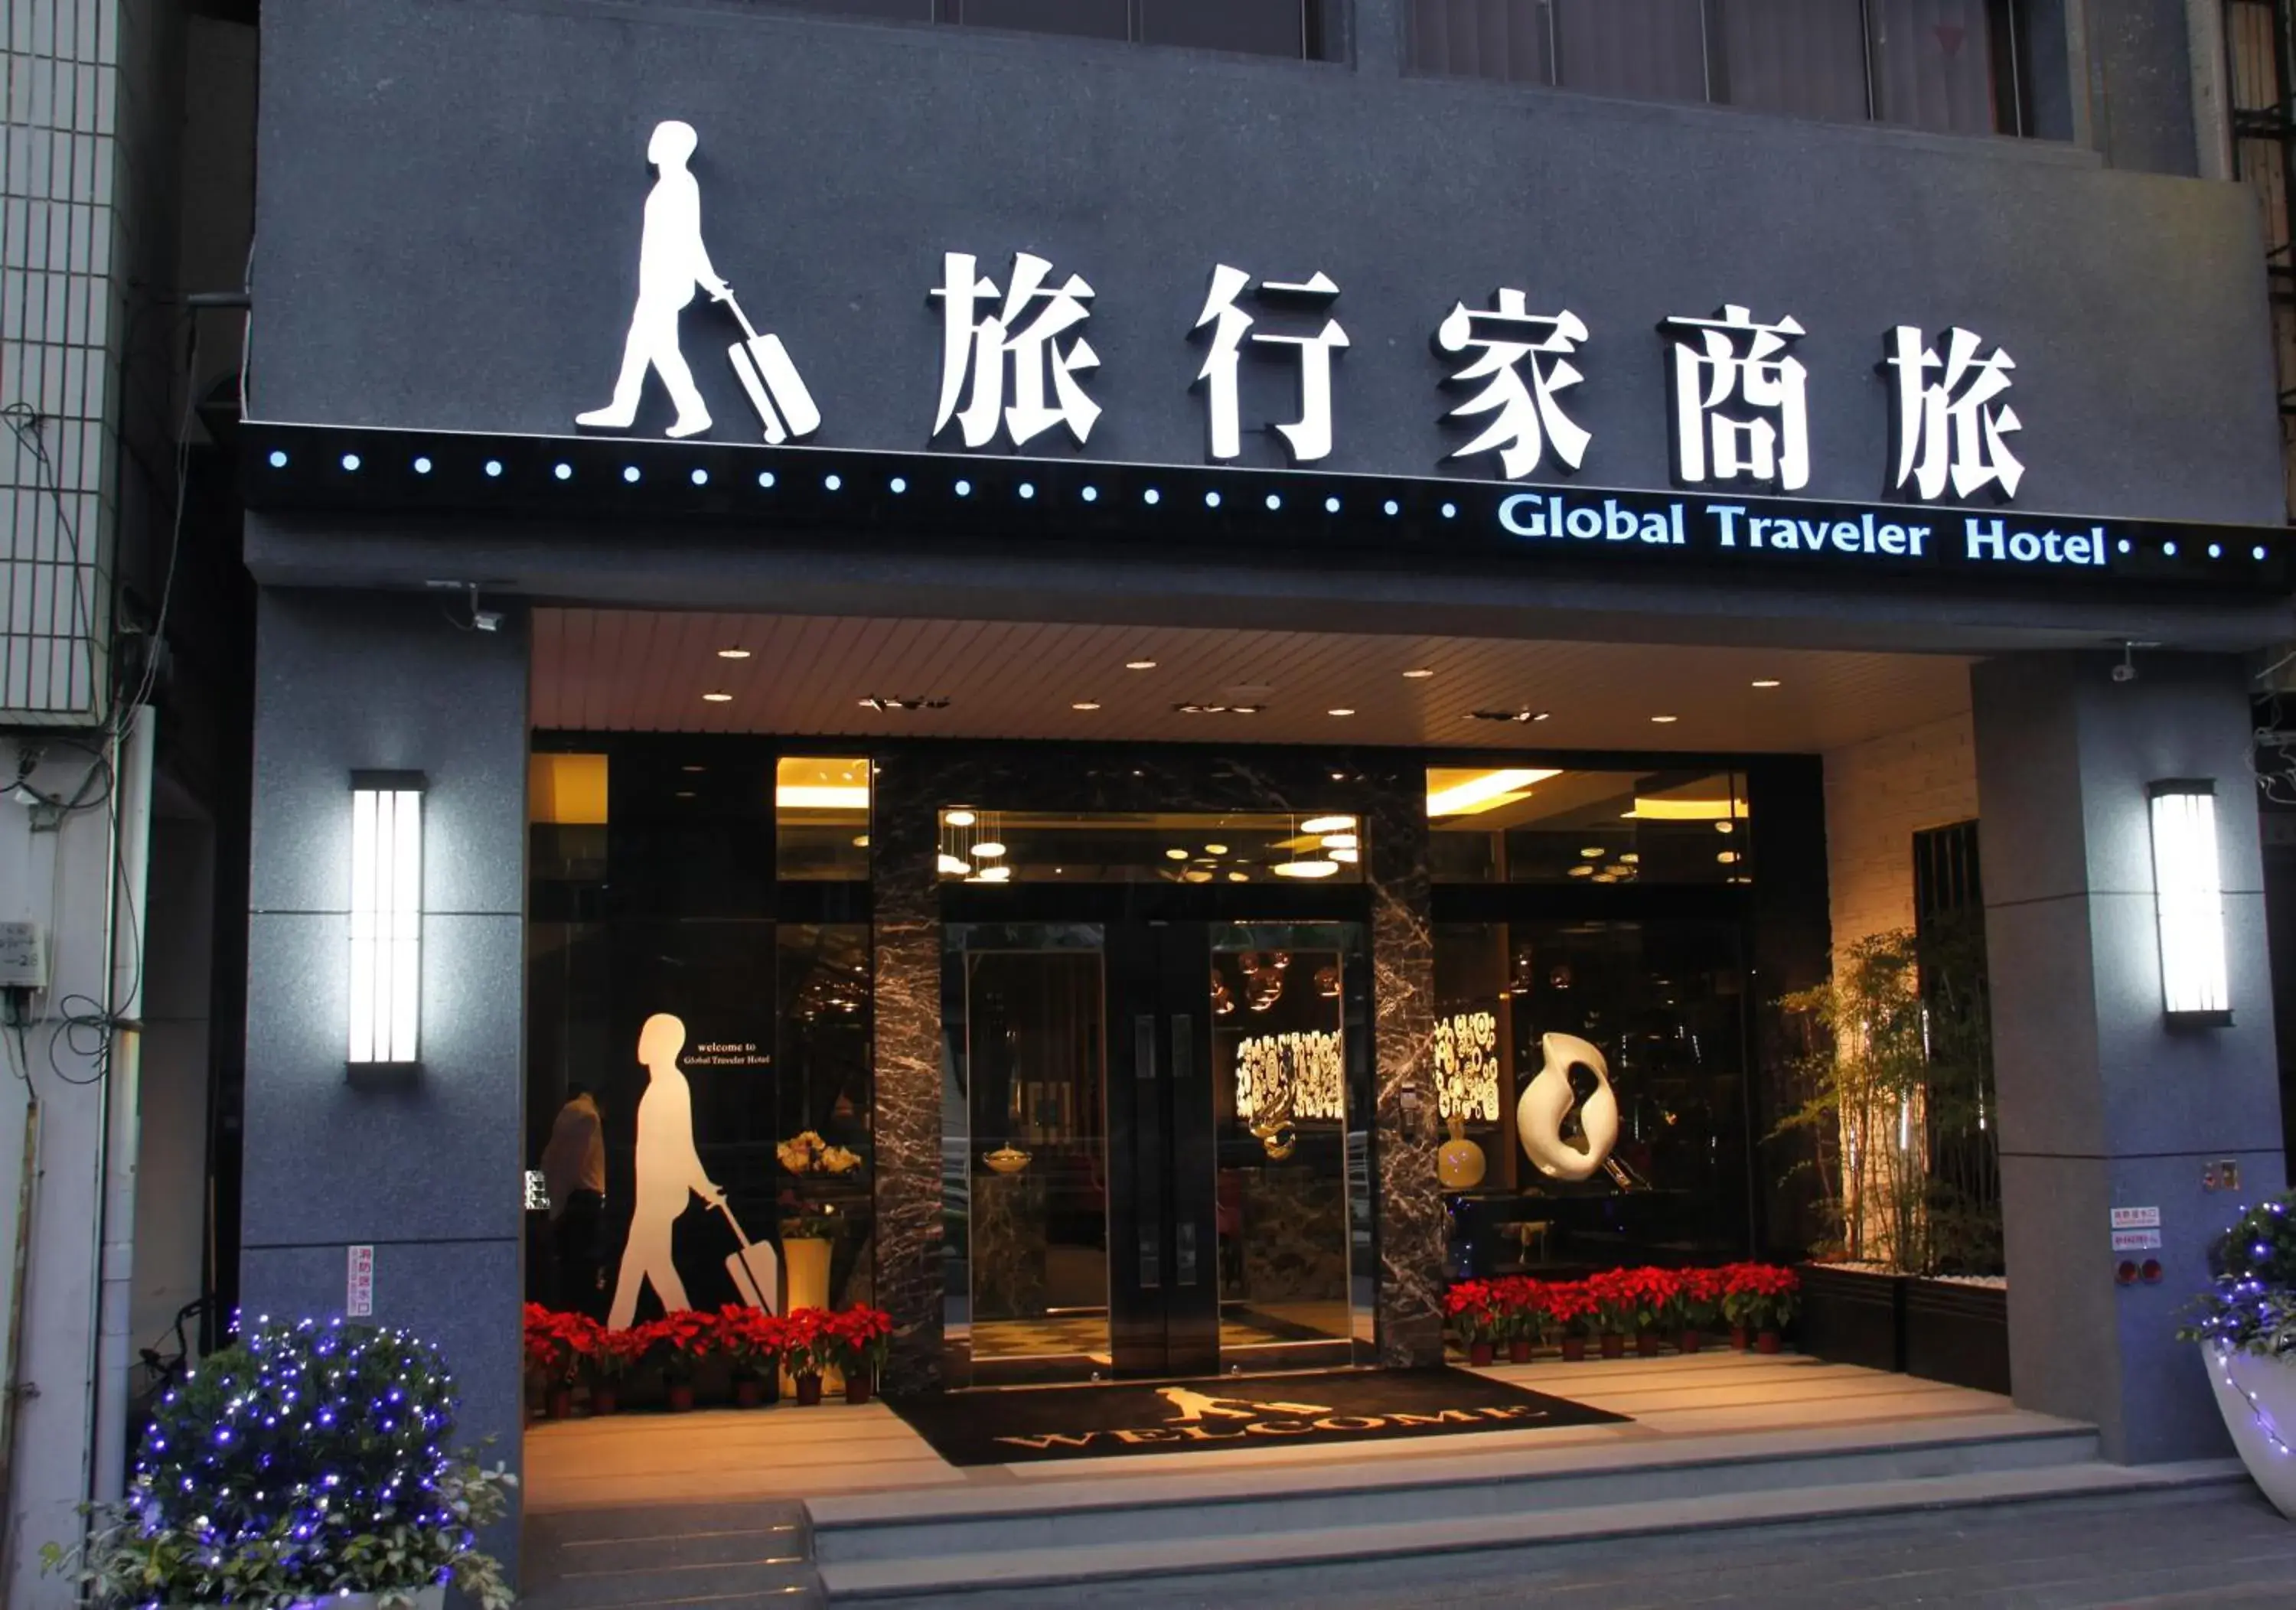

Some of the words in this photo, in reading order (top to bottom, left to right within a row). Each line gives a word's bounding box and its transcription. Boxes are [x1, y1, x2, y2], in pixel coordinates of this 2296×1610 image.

[928, 250, 2027, 500] 旅行家商旅
[1497, 493, 1686, 545] Global
[1705, 504, 1932, 557] Traveler
[1964, 518, 2108, 565] Hotel
[697, 1042, 743, 1052] welcome
[745, 1043, 756, 1051] to
[993, 1404, 1548, 1449] WELCOME
